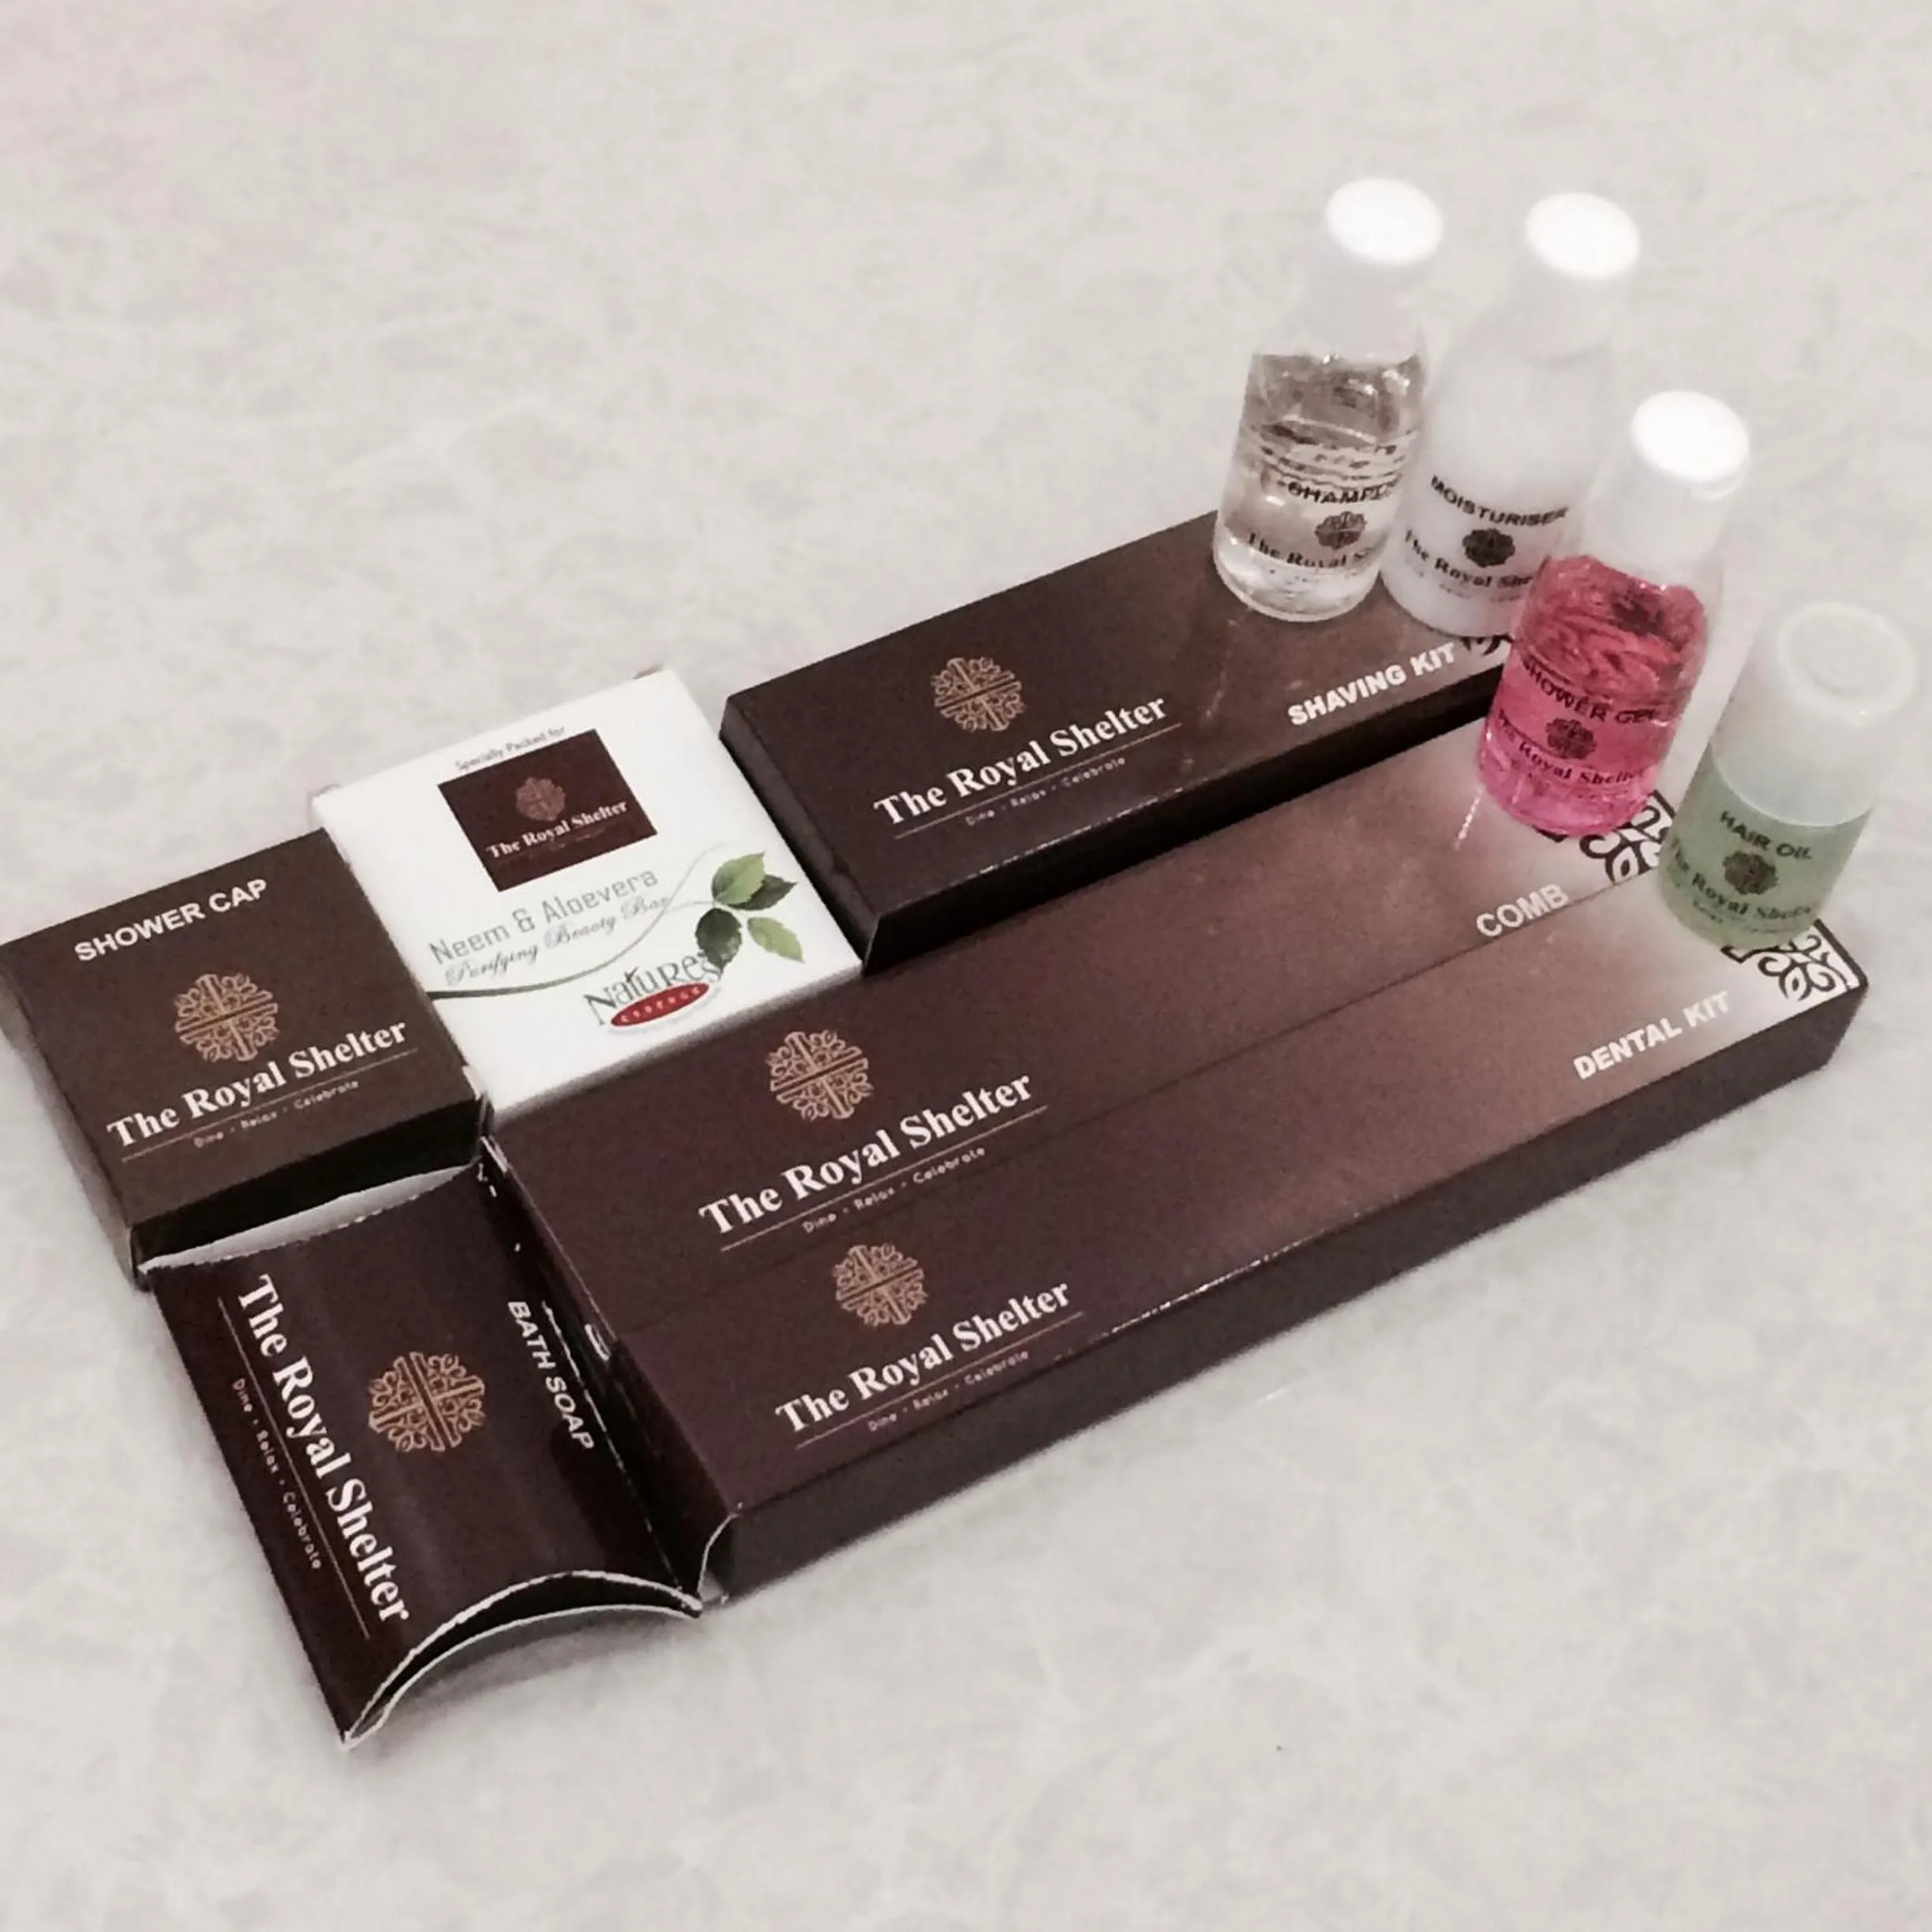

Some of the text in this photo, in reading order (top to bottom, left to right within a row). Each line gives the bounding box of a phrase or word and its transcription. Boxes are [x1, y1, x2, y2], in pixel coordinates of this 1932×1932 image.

[1435, 557, 1492, 587] Royal
[1287, 642, 1458, 726] SHAVING KIT
[874, 695, 1168, 828] The Royal Shelter
[1518, 740, 1573, 781] Royal
[485, 841, 521, 859] The
[522, 821, 571, 847] Royal
[571, 800, 628, 830] Shelter
[1720, 810, 1813, 860] HAIR OIL
[75, 878, 268, 962] SHOWER CAP
[429, 870, 659, 965] Neem & Aloevera
[444, 945, 539, 987] Purifying
[544, 915, 616, 951] Beauty
[1476, 884, 1570, 938] COMB
[1574, 990, 1731, 1080] DENTAL KIT
[107, 1020, 408, 1148] The Royal Shelter
[698, 1074, 1032, 1234] The Royal Shelter
[912, 1148, 985, 1184] Celebrate
[507, 1300, 595, 1451] BATH SOAP
[774, 1282, 1071, 1433] The Royal Shelter
[238, 1273, 410, 1623] The Royal Shelter
[256, 1429, 279, 1474] Relax
[283, 1491, 322, 1570] Celebrate
